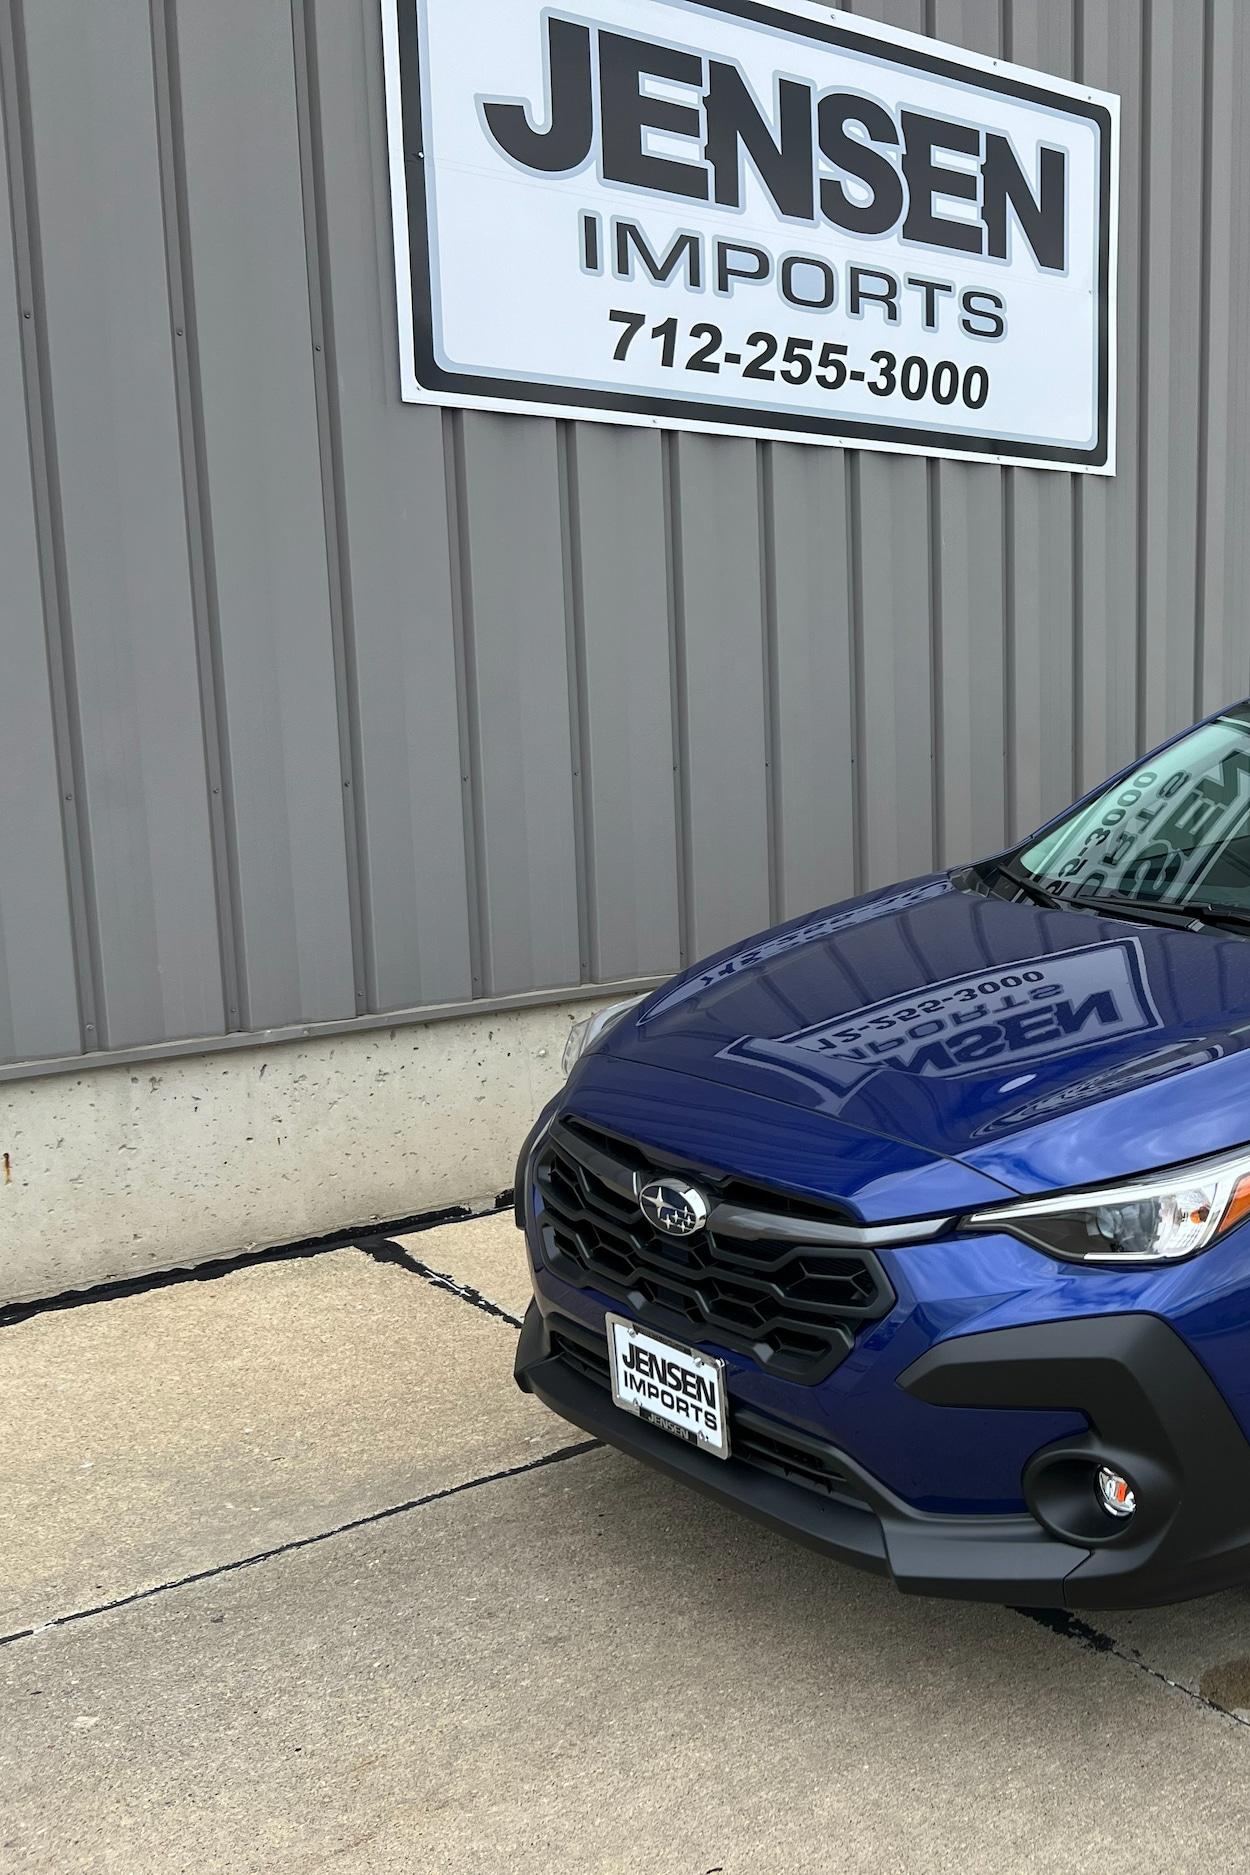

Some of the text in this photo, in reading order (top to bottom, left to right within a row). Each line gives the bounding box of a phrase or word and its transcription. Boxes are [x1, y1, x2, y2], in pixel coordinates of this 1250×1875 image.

[480, 13, 1067, 273] JENSEN
[583, 214, 1005, 338] IMPORTS
[609, 310, 990, 409] 712-255-3000
[622, 1342, 717, 1410] JENSEN
[624, 1371, 718, 1431] IMPORTS
[648, 1413, 690, 1440] JENSEN
